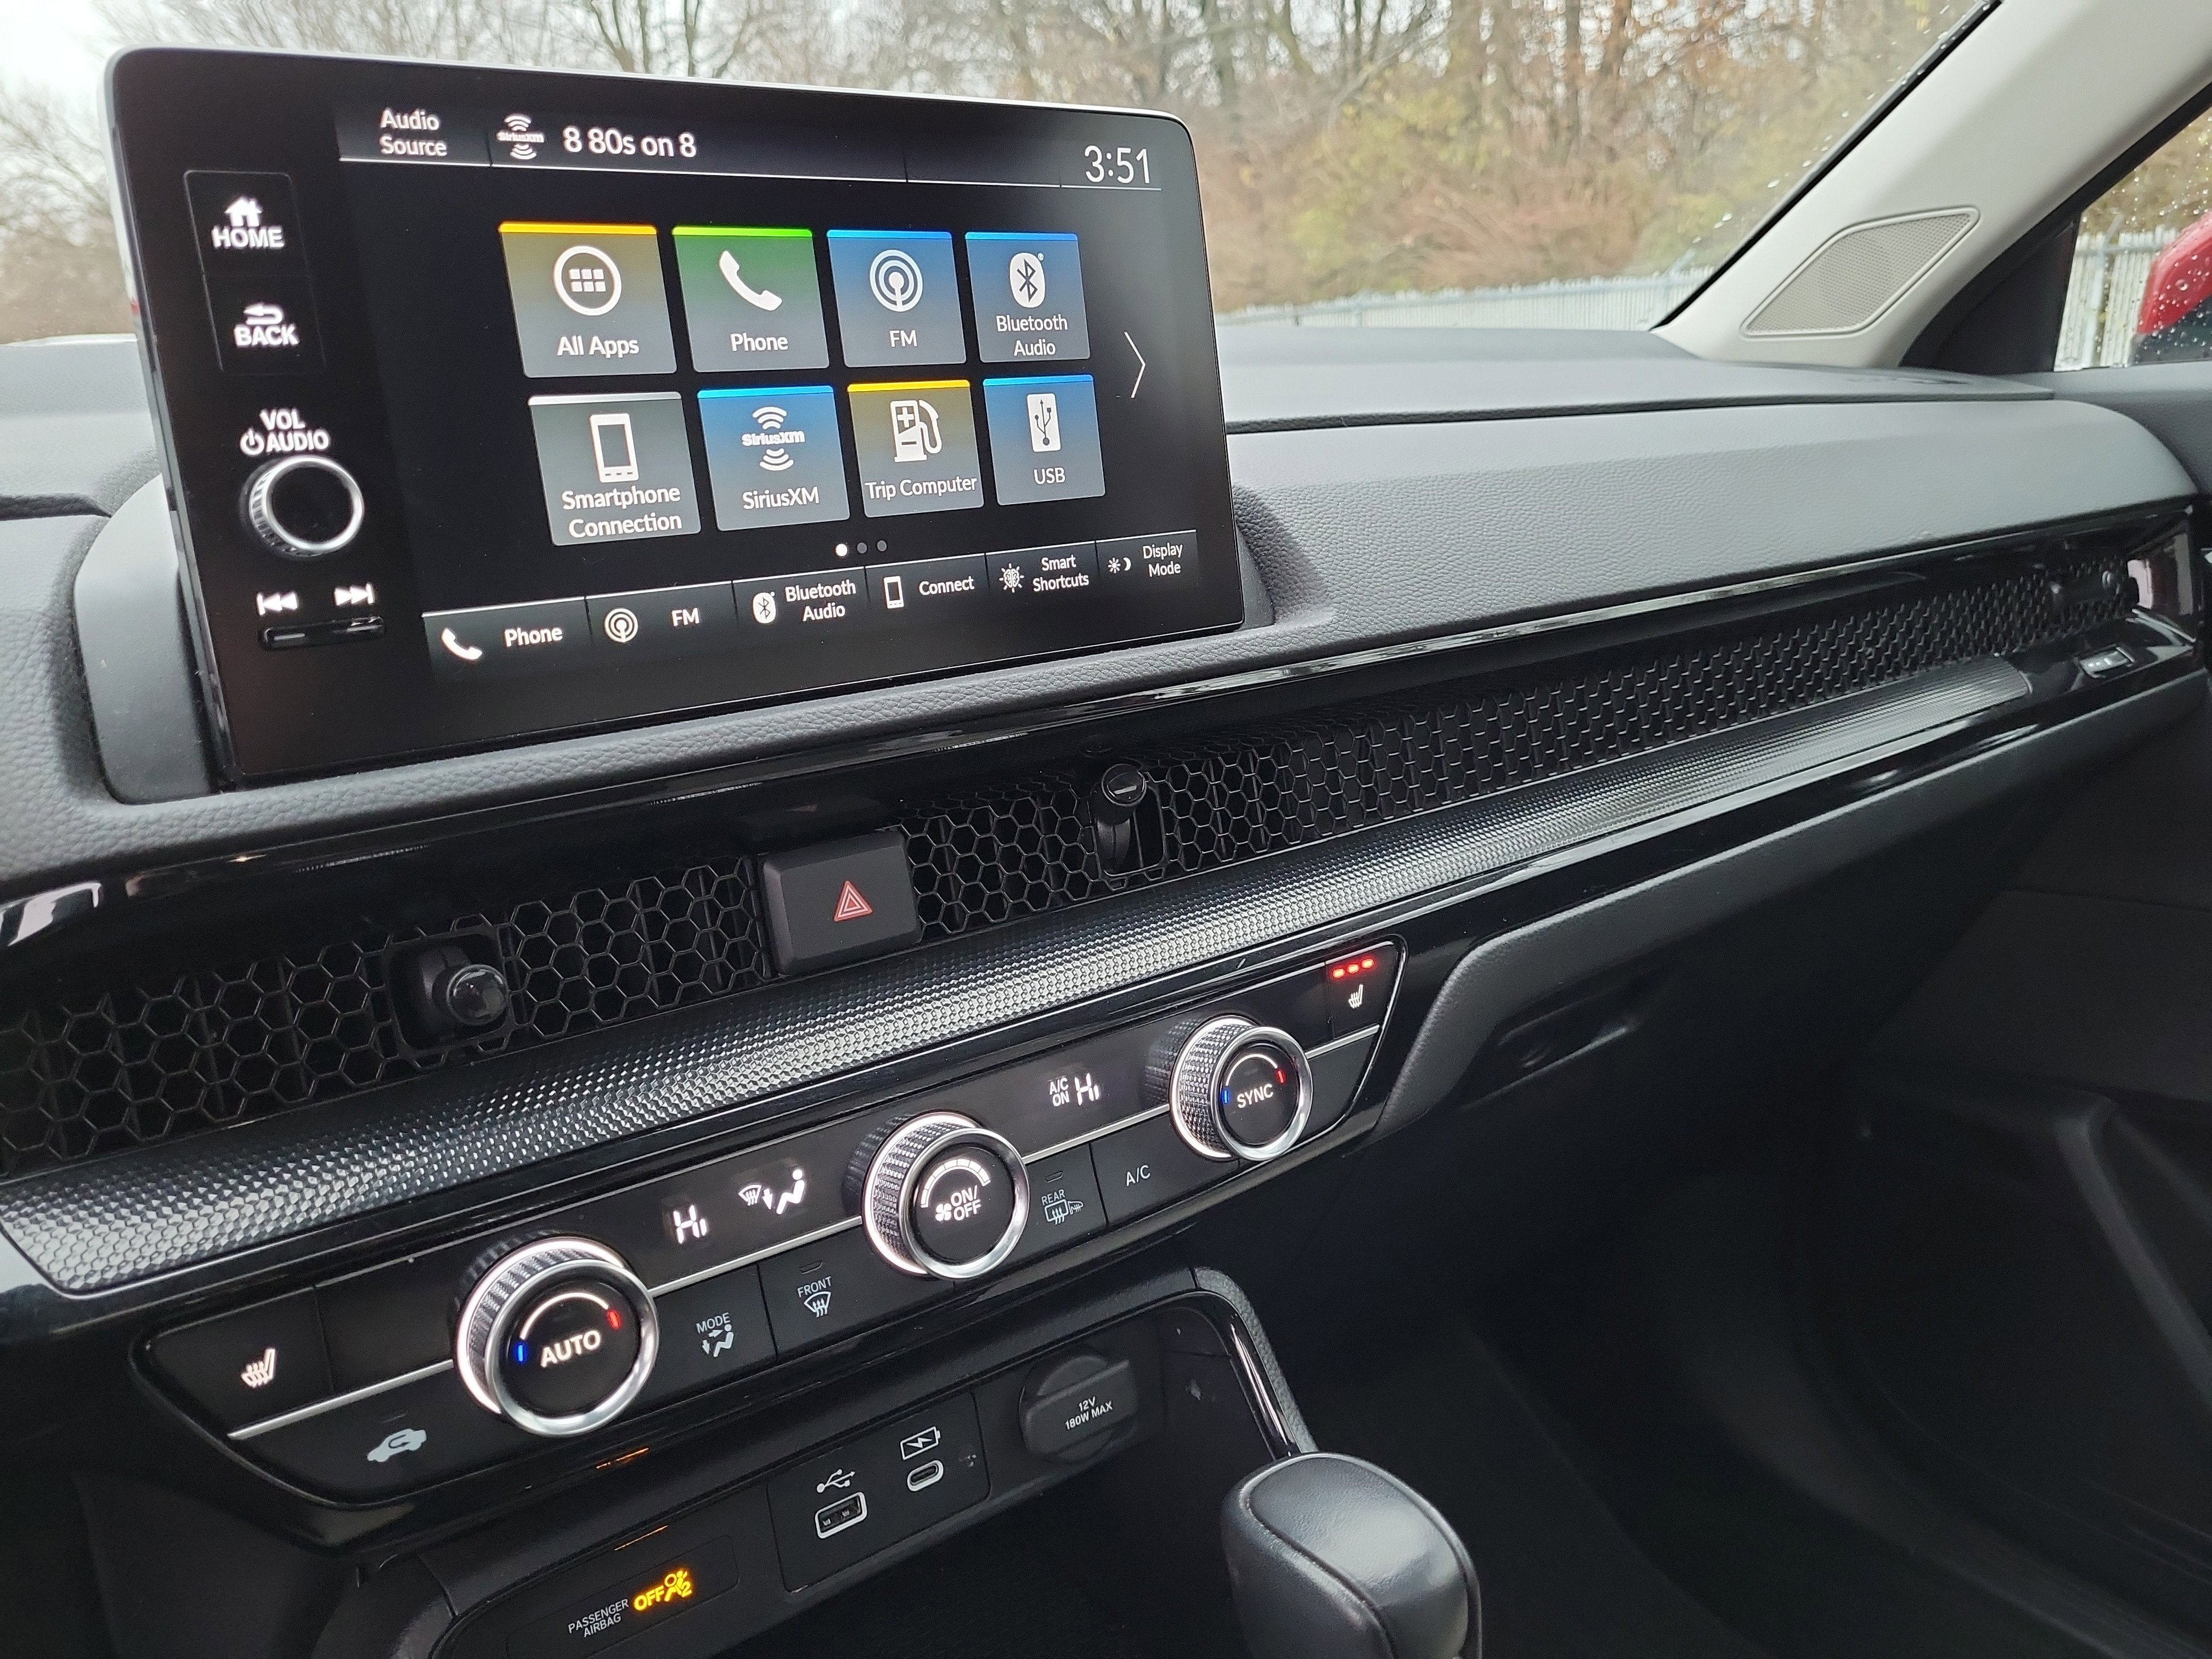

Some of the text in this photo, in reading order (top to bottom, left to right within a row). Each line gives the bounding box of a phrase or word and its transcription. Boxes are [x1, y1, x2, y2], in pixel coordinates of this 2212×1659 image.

[381, 108, 440, 132] Audio
[381, 135, 448, 158] Source
[563, 126, 697, 158] 8 80s on 8
[1084, 145, 1150, 184] 3:51
[211, 225, 285, 249] HOME
[996, 313, 1069, 332] Bluetooth
[234, 325, 299, 348] BACK
[557, 335, 640, 358] All Apps
[730, 334, 789, 352] Phone
[889, 330, 918, 348] FM
[1013, 339, 1056, 357] Audio
[260, 408, 305, 431] VOL
[266, 428, 330, 453] AUDIO
[1034, 467, 1065, 485] USB
[562, 486, 681, 510] Smartphone
[742, 487, 820, 510] SiriusXM
[865, 476, 977, 501] Trip Computer
[568, 514, 682, 539] Connection
[1143, 542, 1183, 560] Display
[1041, 554, 1076, 572] Smart
[1149, 561, 1181, 578] Mode
[785, 579, 857, 602] Bluetooth
[918, 575, 975, 595] Connect
[1033, 574, 1090, 592] Shortcuts
[671, 607, 700, 627] FM
[802, 605, 846, 622] Audio
[504, 627, 563, 647] Phone
[1049, 1077, 1069, 1095] A/C
[1237, 1084, 1274, 1109] SYNC
[1052, 1093, 1069, 1107] ON
[1126, 1165, 1151, 1186] A/C
[950, 1185, 978, 1206] ON/
[1041, 1189, 1065, 1205] REAR
[953, 1199, 981, 1221] OFF
[797, 1276, 832, 1298] FRONT
[696, 1313, 731, 1334] MODE
[540, 1330, 601, 1367] AUTO
[1079, 1396, 1096, 1411] 12V
[1065, 1401, 1113, 1429] 180W MAX
[634, 1585, 664, 1610] OFF
[567, 1599, 629, 1633] PASSENGER
[583, 1613, 621, 1638] AIRBAG
